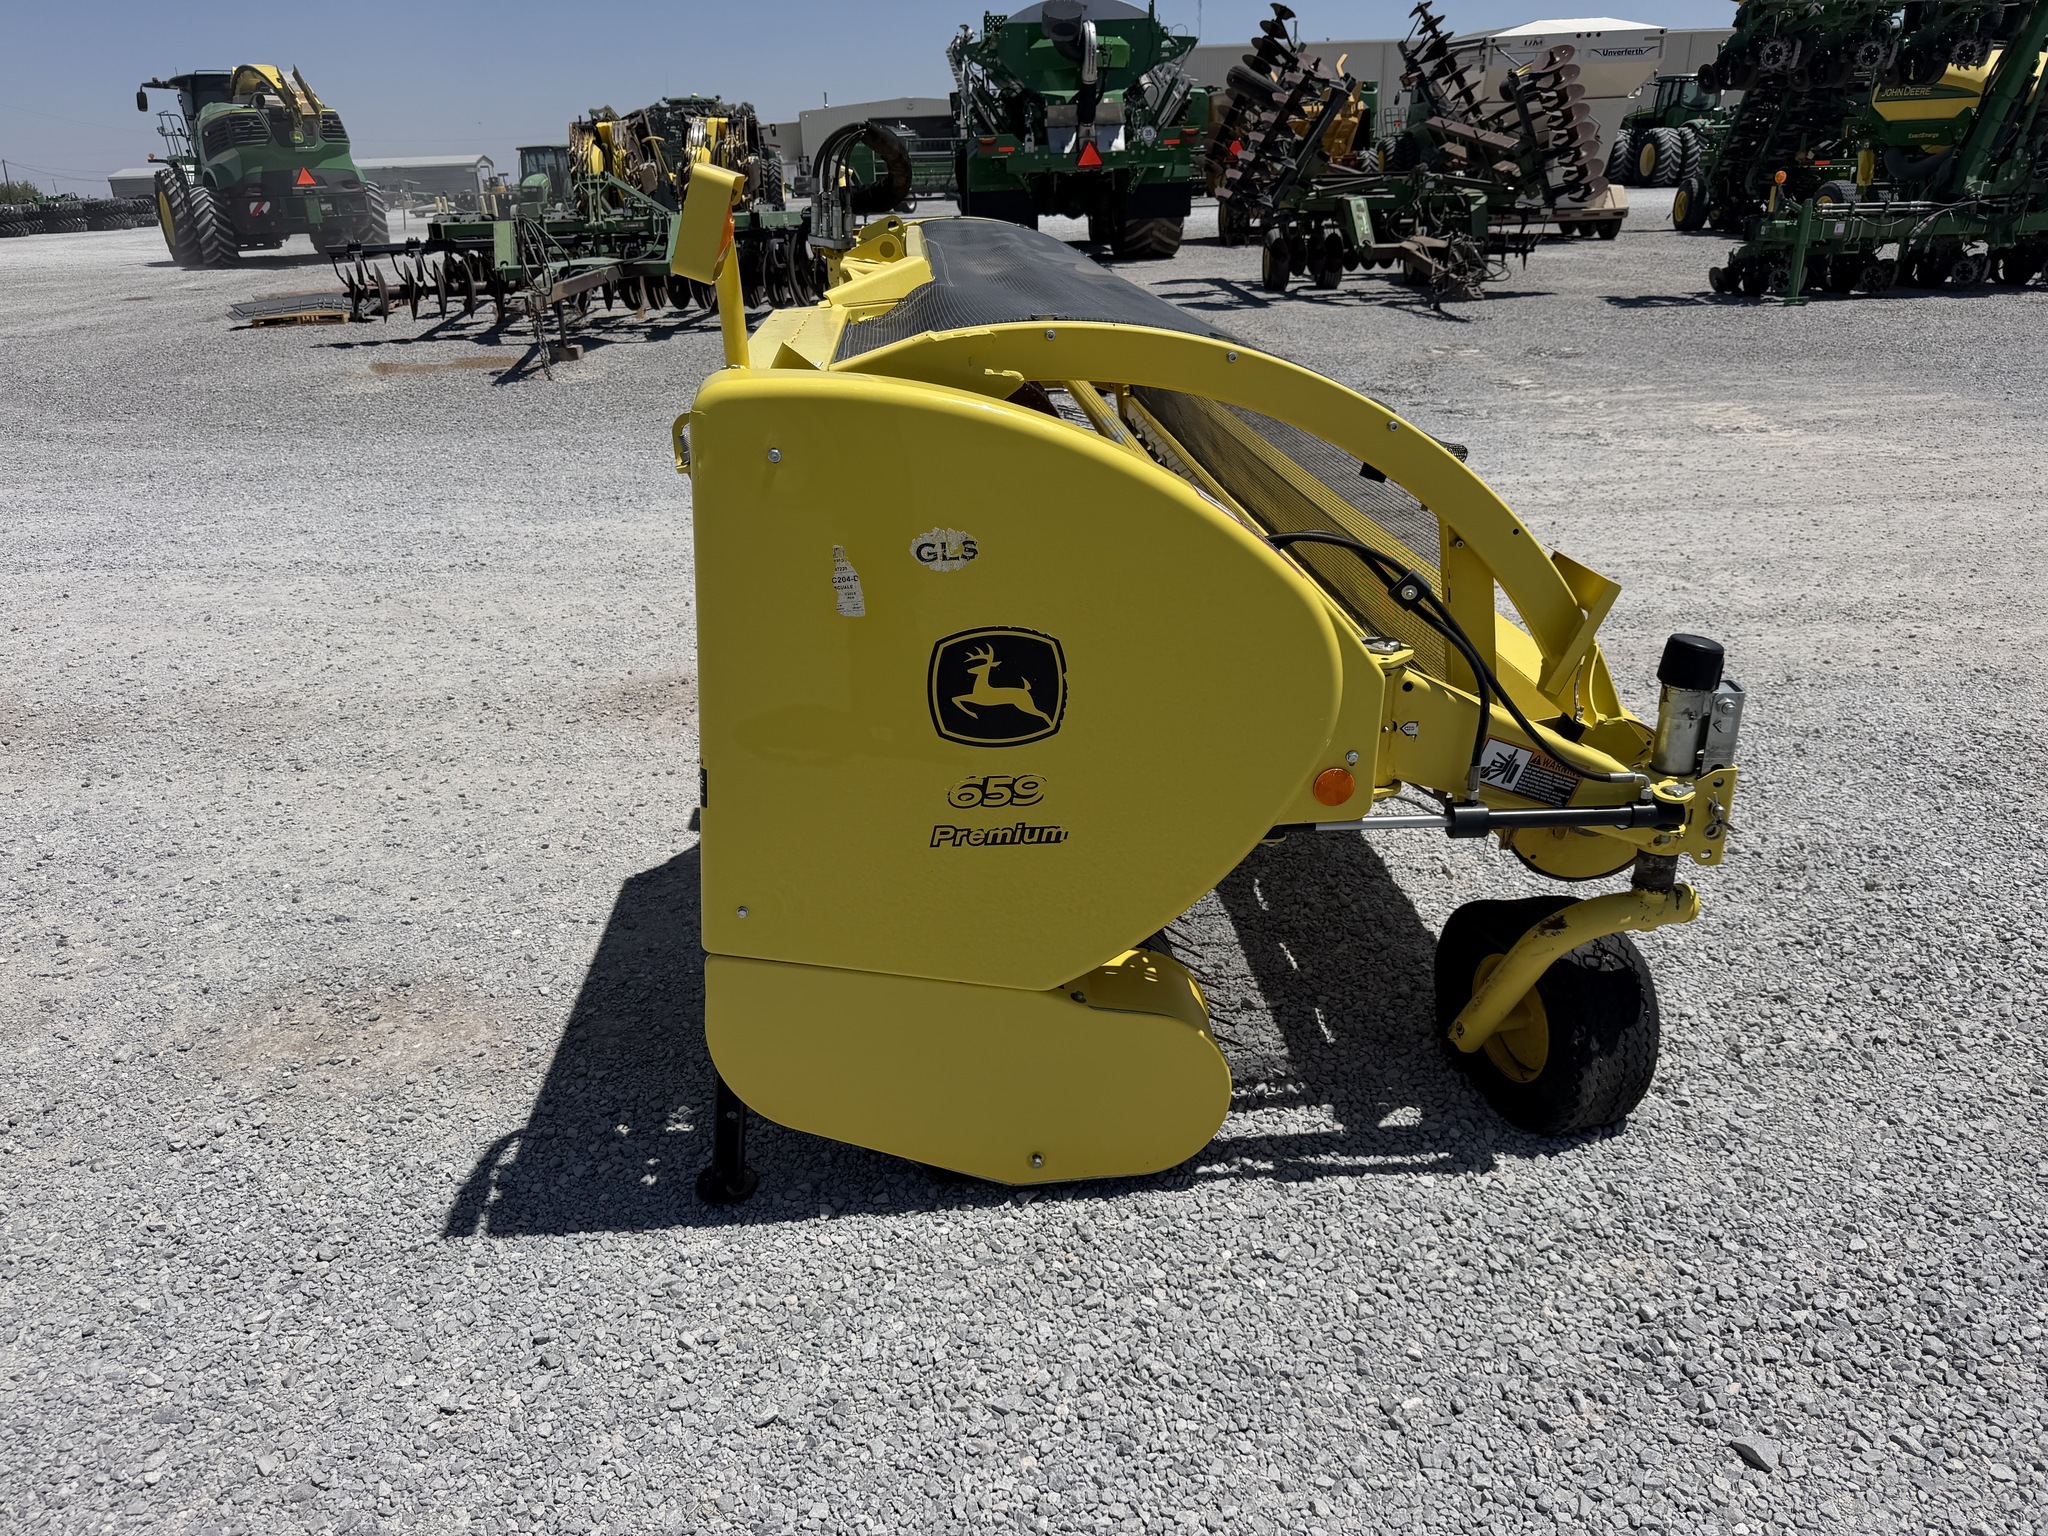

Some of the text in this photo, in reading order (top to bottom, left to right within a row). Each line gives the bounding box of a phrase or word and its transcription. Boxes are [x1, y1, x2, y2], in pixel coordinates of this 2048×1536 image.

[1602, 47, 1644, 57] Unverferth
[1881, 86, 1932, 97] JOHN DEERE
[916, 540, 979, 563] GLS
[947, 774, 1048, 809] 659
[929, 822, 1069, 848] Premium
